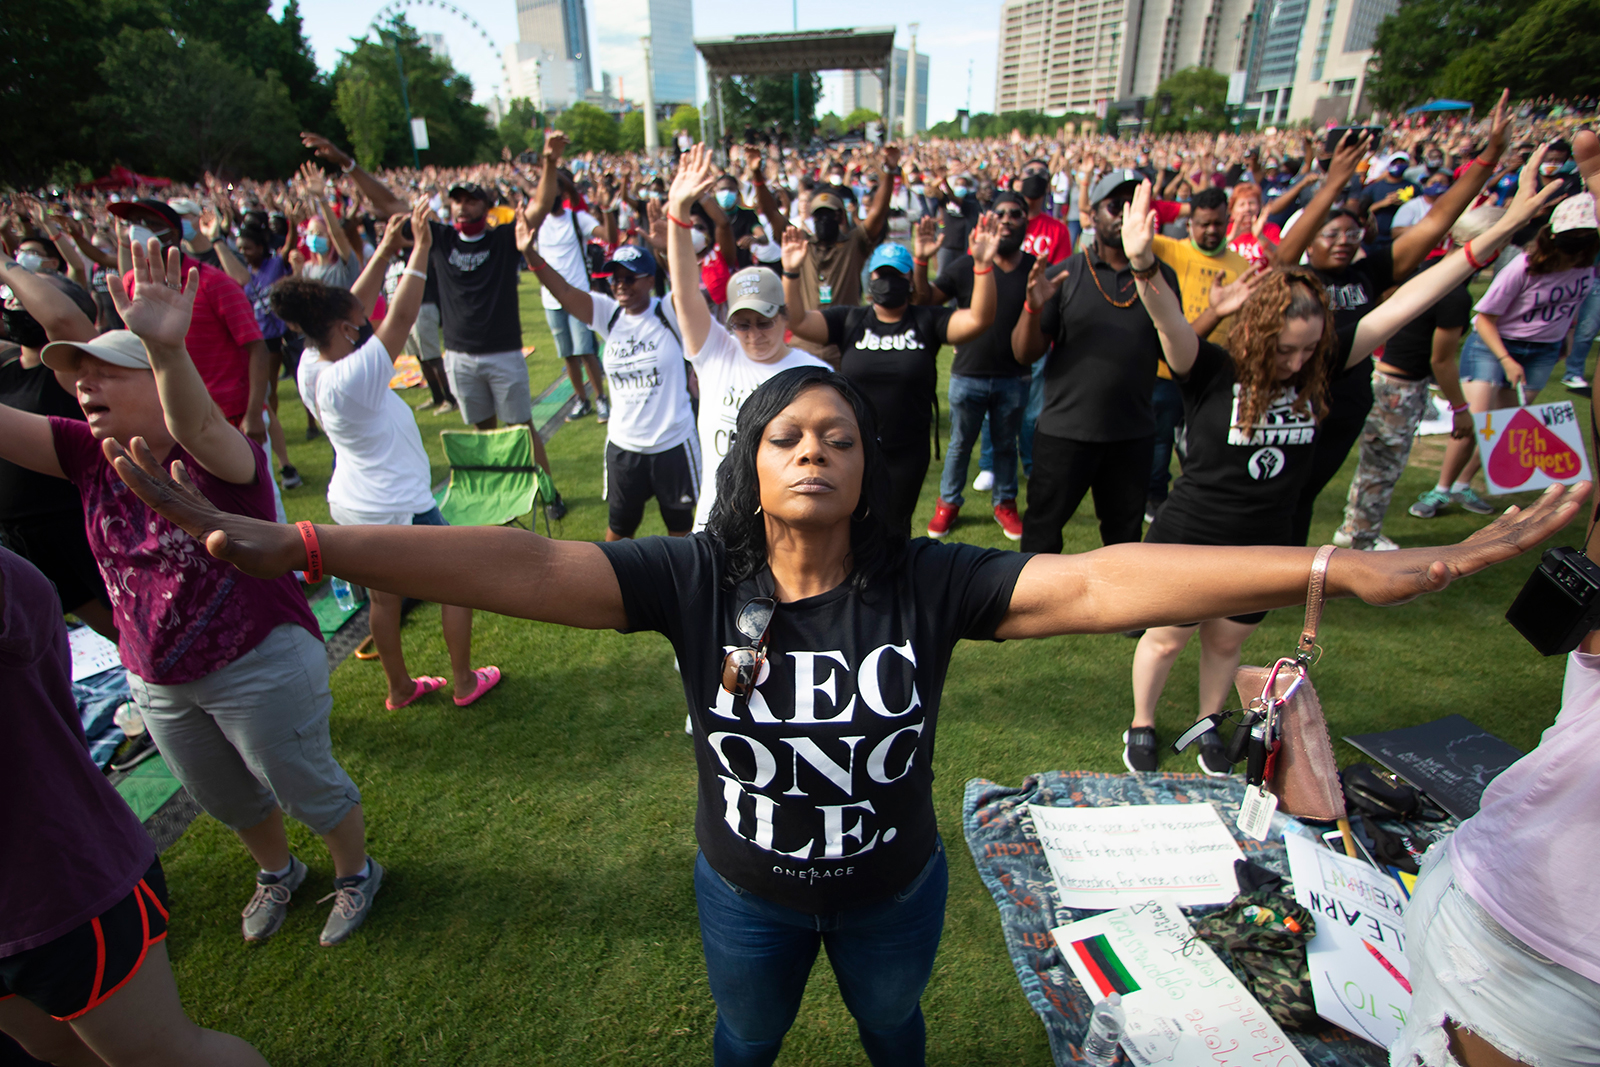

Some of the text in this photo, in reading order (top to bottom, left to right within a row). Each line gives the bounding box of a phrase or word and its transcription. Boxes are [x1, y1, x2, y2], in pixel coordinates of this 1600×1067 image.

[606, 335, 658, 358] Sisters
[610, 367, 664, 391] Christ
[1227, 427, 1315, 446] MATTER
[708, 639, 921, 723] REC
[707, 717, 925, 796] ONC
[718, 775, 897, 860] ILE.
[1030, 808, 1063, 833] You
[984, 842, 1040, 858] LIGHT
[1083, 842, 1104, 861] for
[1344, 980, 1382, 1020] TO
